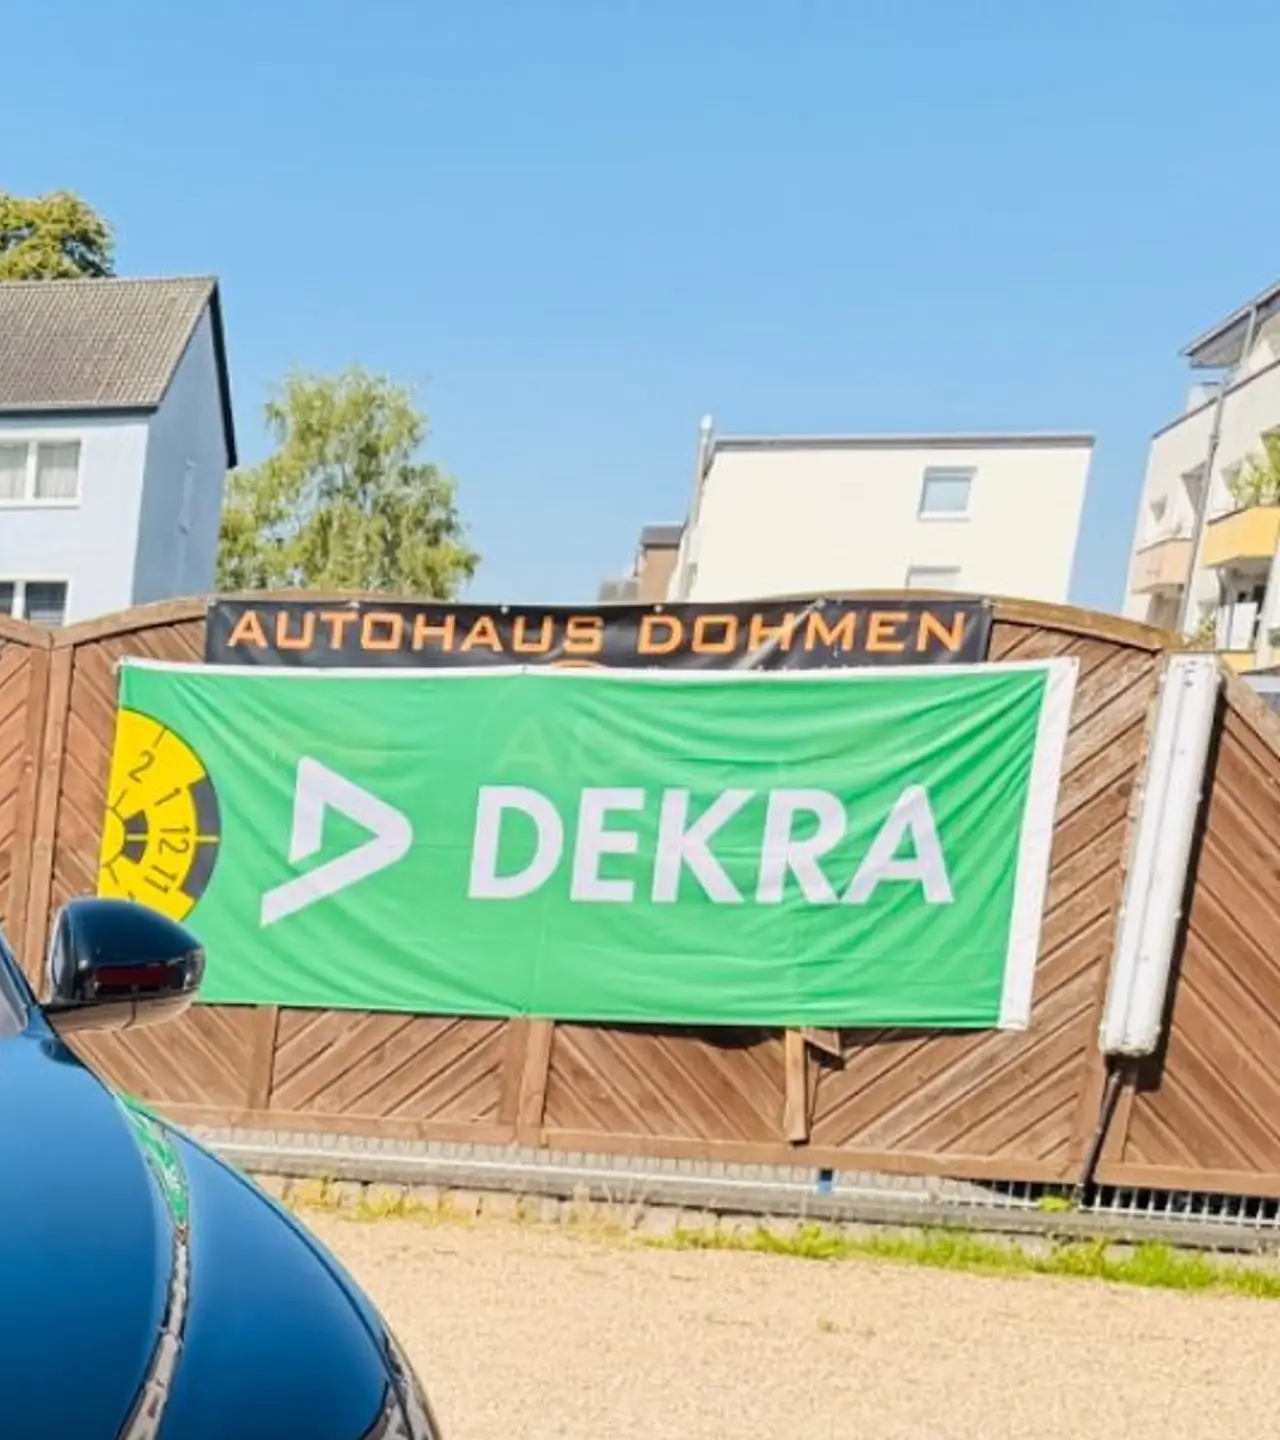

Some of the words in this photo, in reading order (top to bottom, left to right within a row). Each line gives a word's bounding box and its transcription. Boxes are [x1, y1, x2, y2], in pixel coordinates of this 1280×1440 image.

[226, 610, 606, 655] AUTOHAUS
[637, 610, 967, 655] DOHMEN
[128, 750, 156, 784] 2
[158, 825, 191, 855] 12
[466, 784, 953, 905] DEKRA
[143, 864, 178, 894] 11
